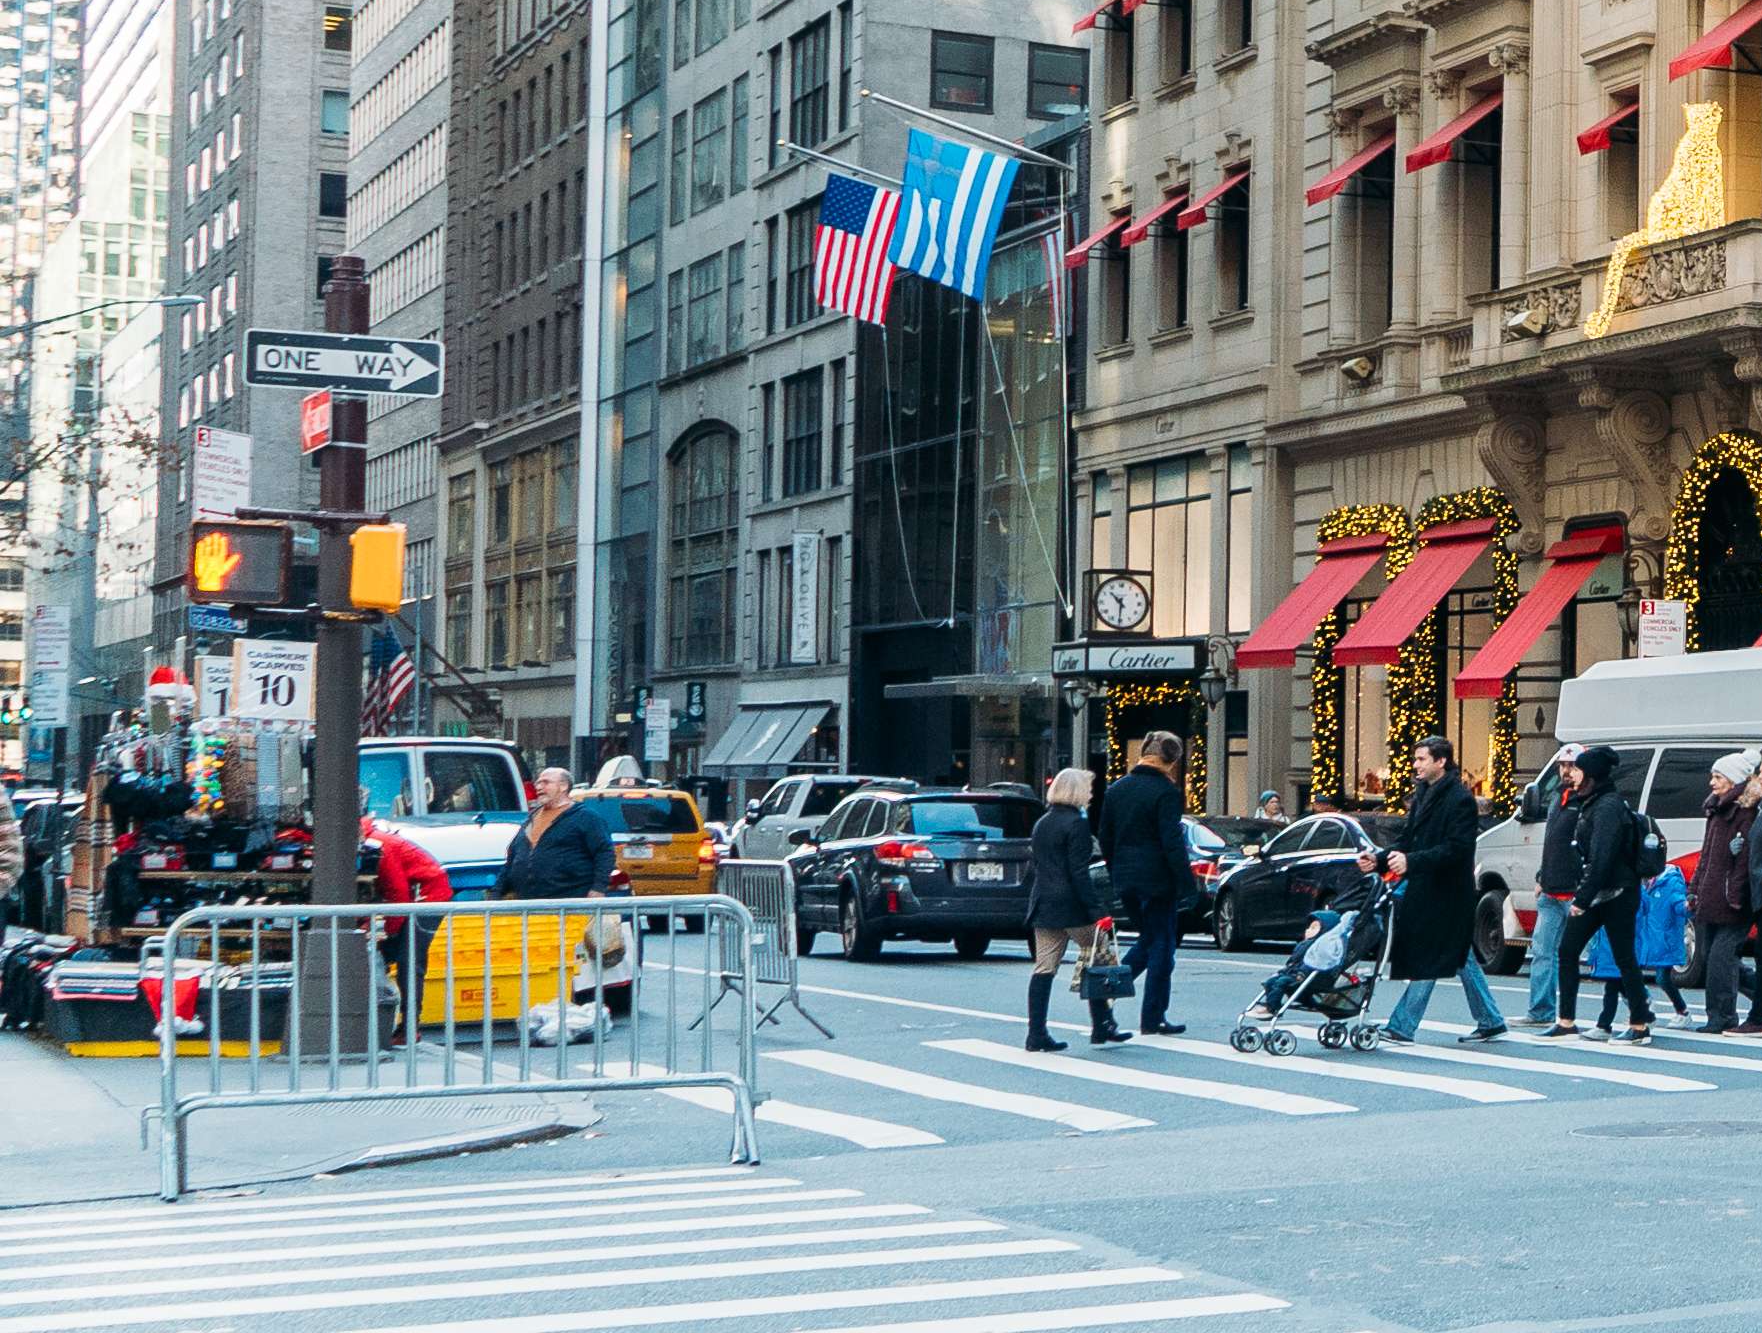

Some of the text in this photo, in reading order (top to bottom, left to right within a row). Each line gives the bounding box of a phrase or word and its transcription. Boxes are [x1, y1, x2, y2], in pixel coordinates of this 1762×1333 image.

[264, 348, 415, 377] ONE WAY
[1644, 601, 1653, 614] 3
[247, 651, 308, 662] CASHMERE
[1057, 651, 1079, 671] Cartier
[1109, 647, 1175, 669] Cartier
[249, 661, 305, 672] SCARVES
